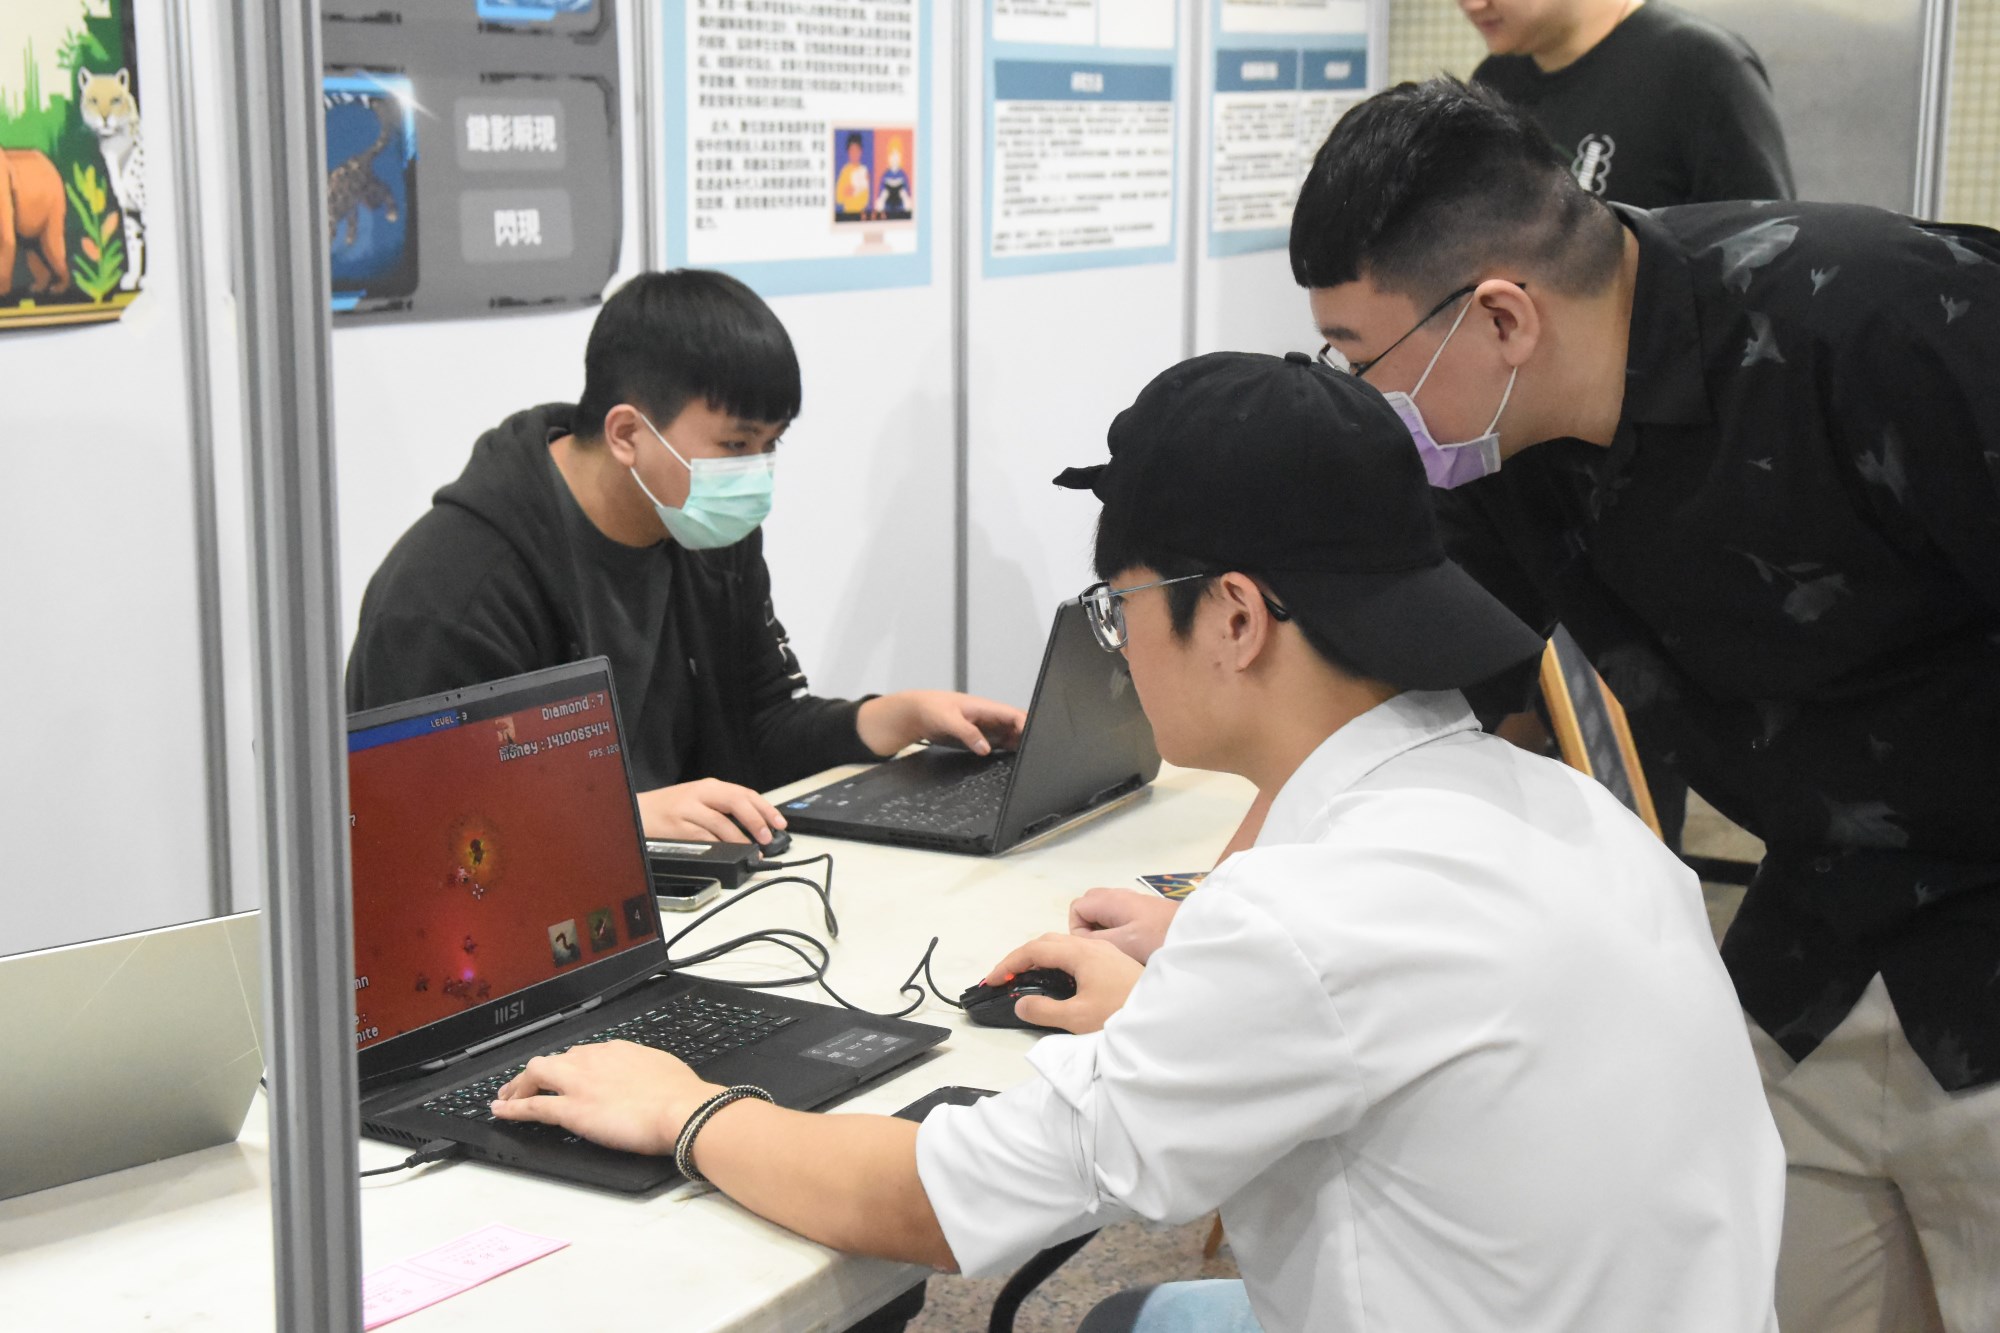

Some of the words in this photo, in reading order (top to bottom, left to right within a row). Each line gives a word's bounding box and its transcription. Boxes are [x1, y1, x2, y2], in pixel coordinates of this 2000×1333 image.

[494, 209, 542, 246] 閃現
[430, 714, 455, 728] LEVEL
[462, 712, 468, 721] 3
